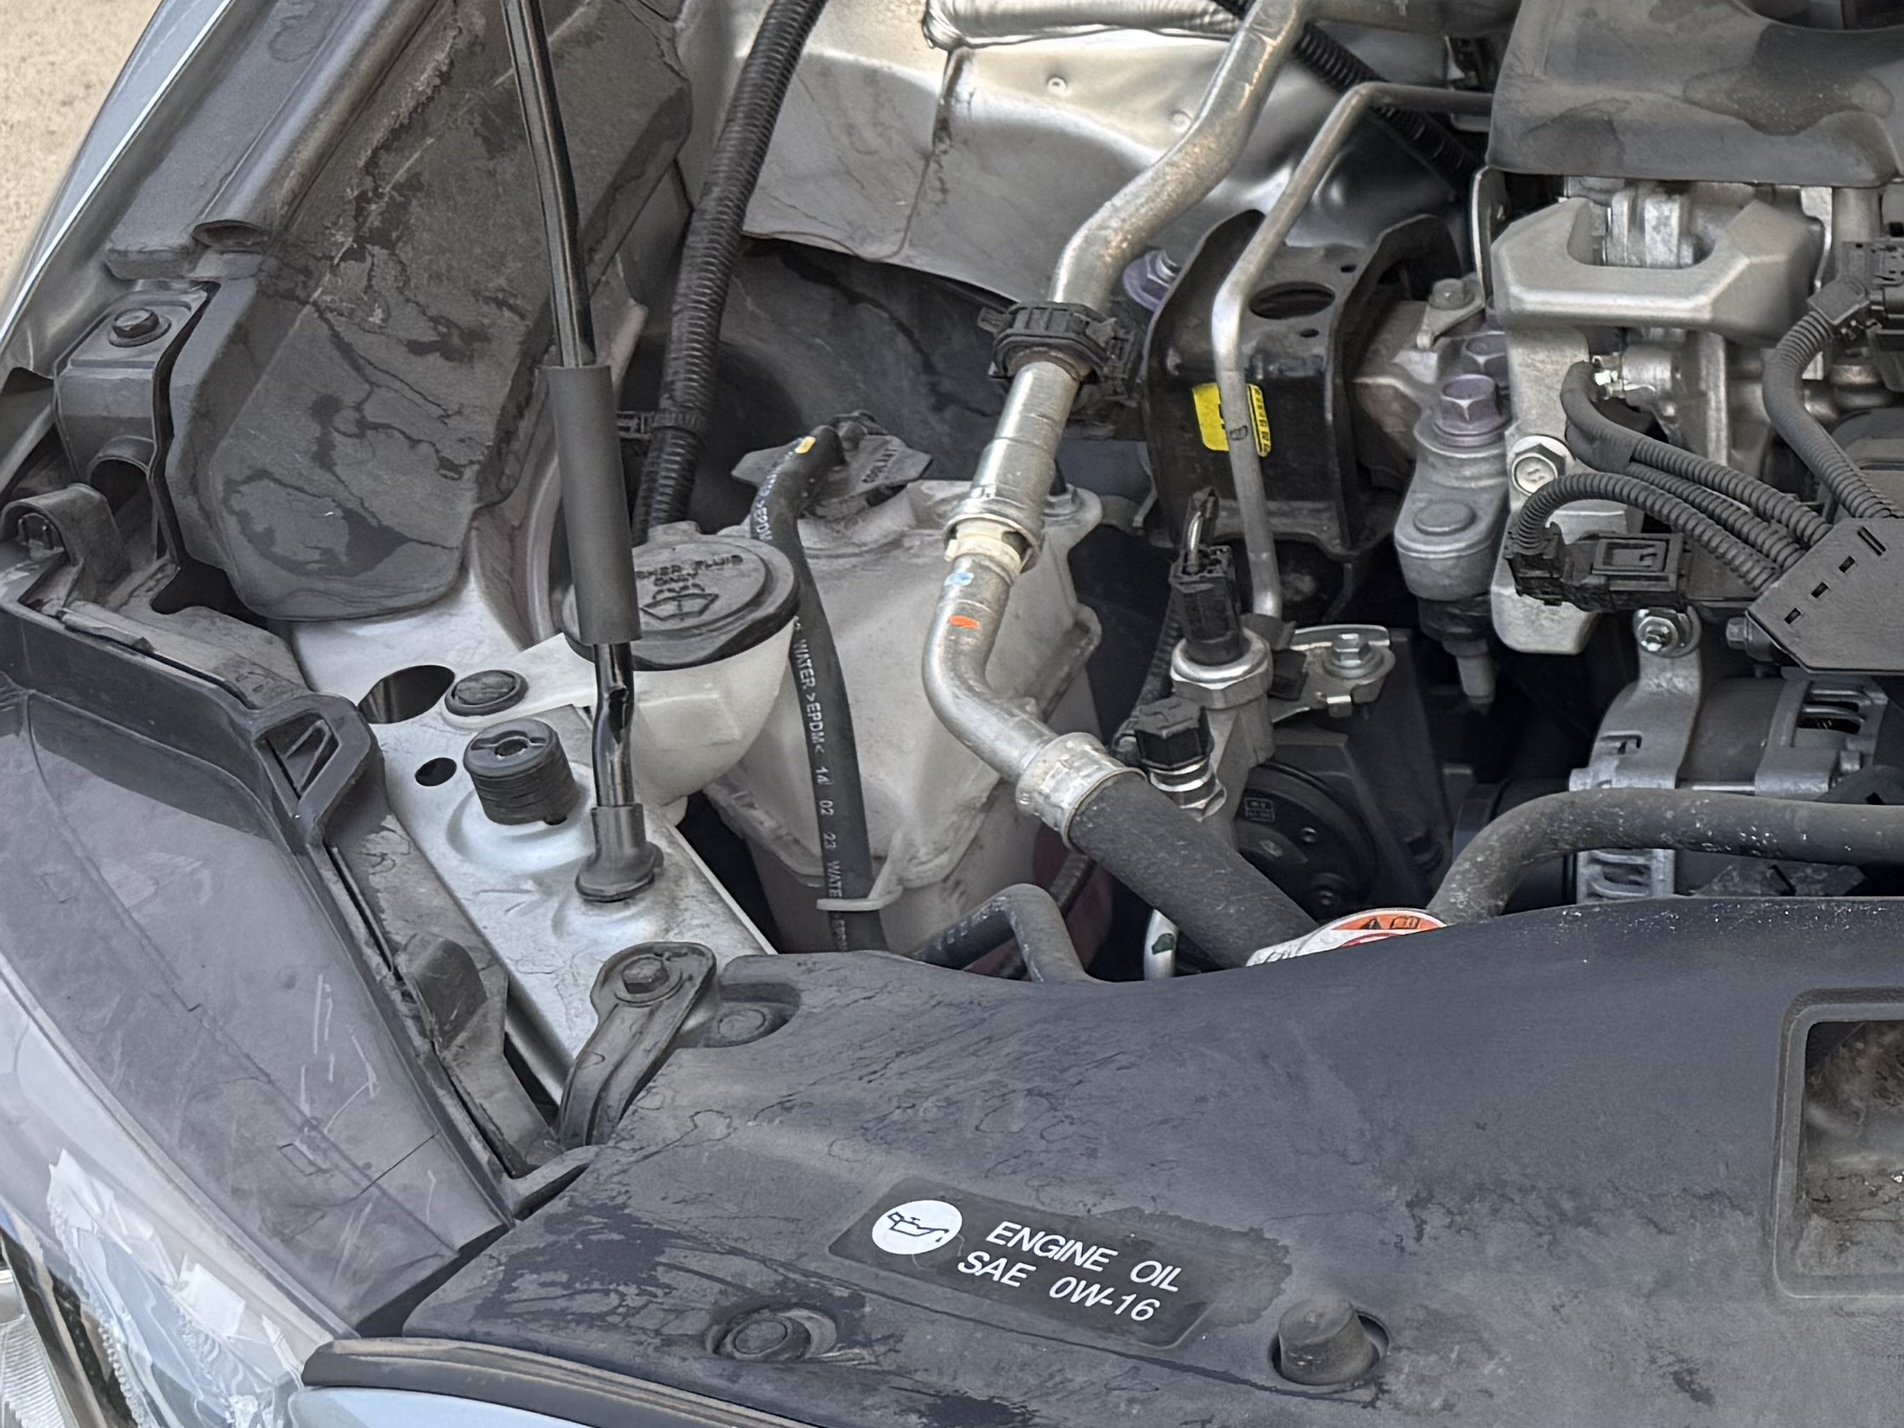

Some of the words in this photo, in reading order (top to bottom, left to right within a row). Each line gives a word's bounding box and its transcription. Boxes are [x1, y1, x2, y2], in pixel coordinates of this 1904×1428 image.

[827, 861, 843, 899] WATE
[957, 1251, 1037, 1288] SAE
[1049, 1276, 1161, 1321] 0W-16
[986, 1221, 1118, 1272] ENGINE
[1130, 1260, 1182, 1292] OIL
